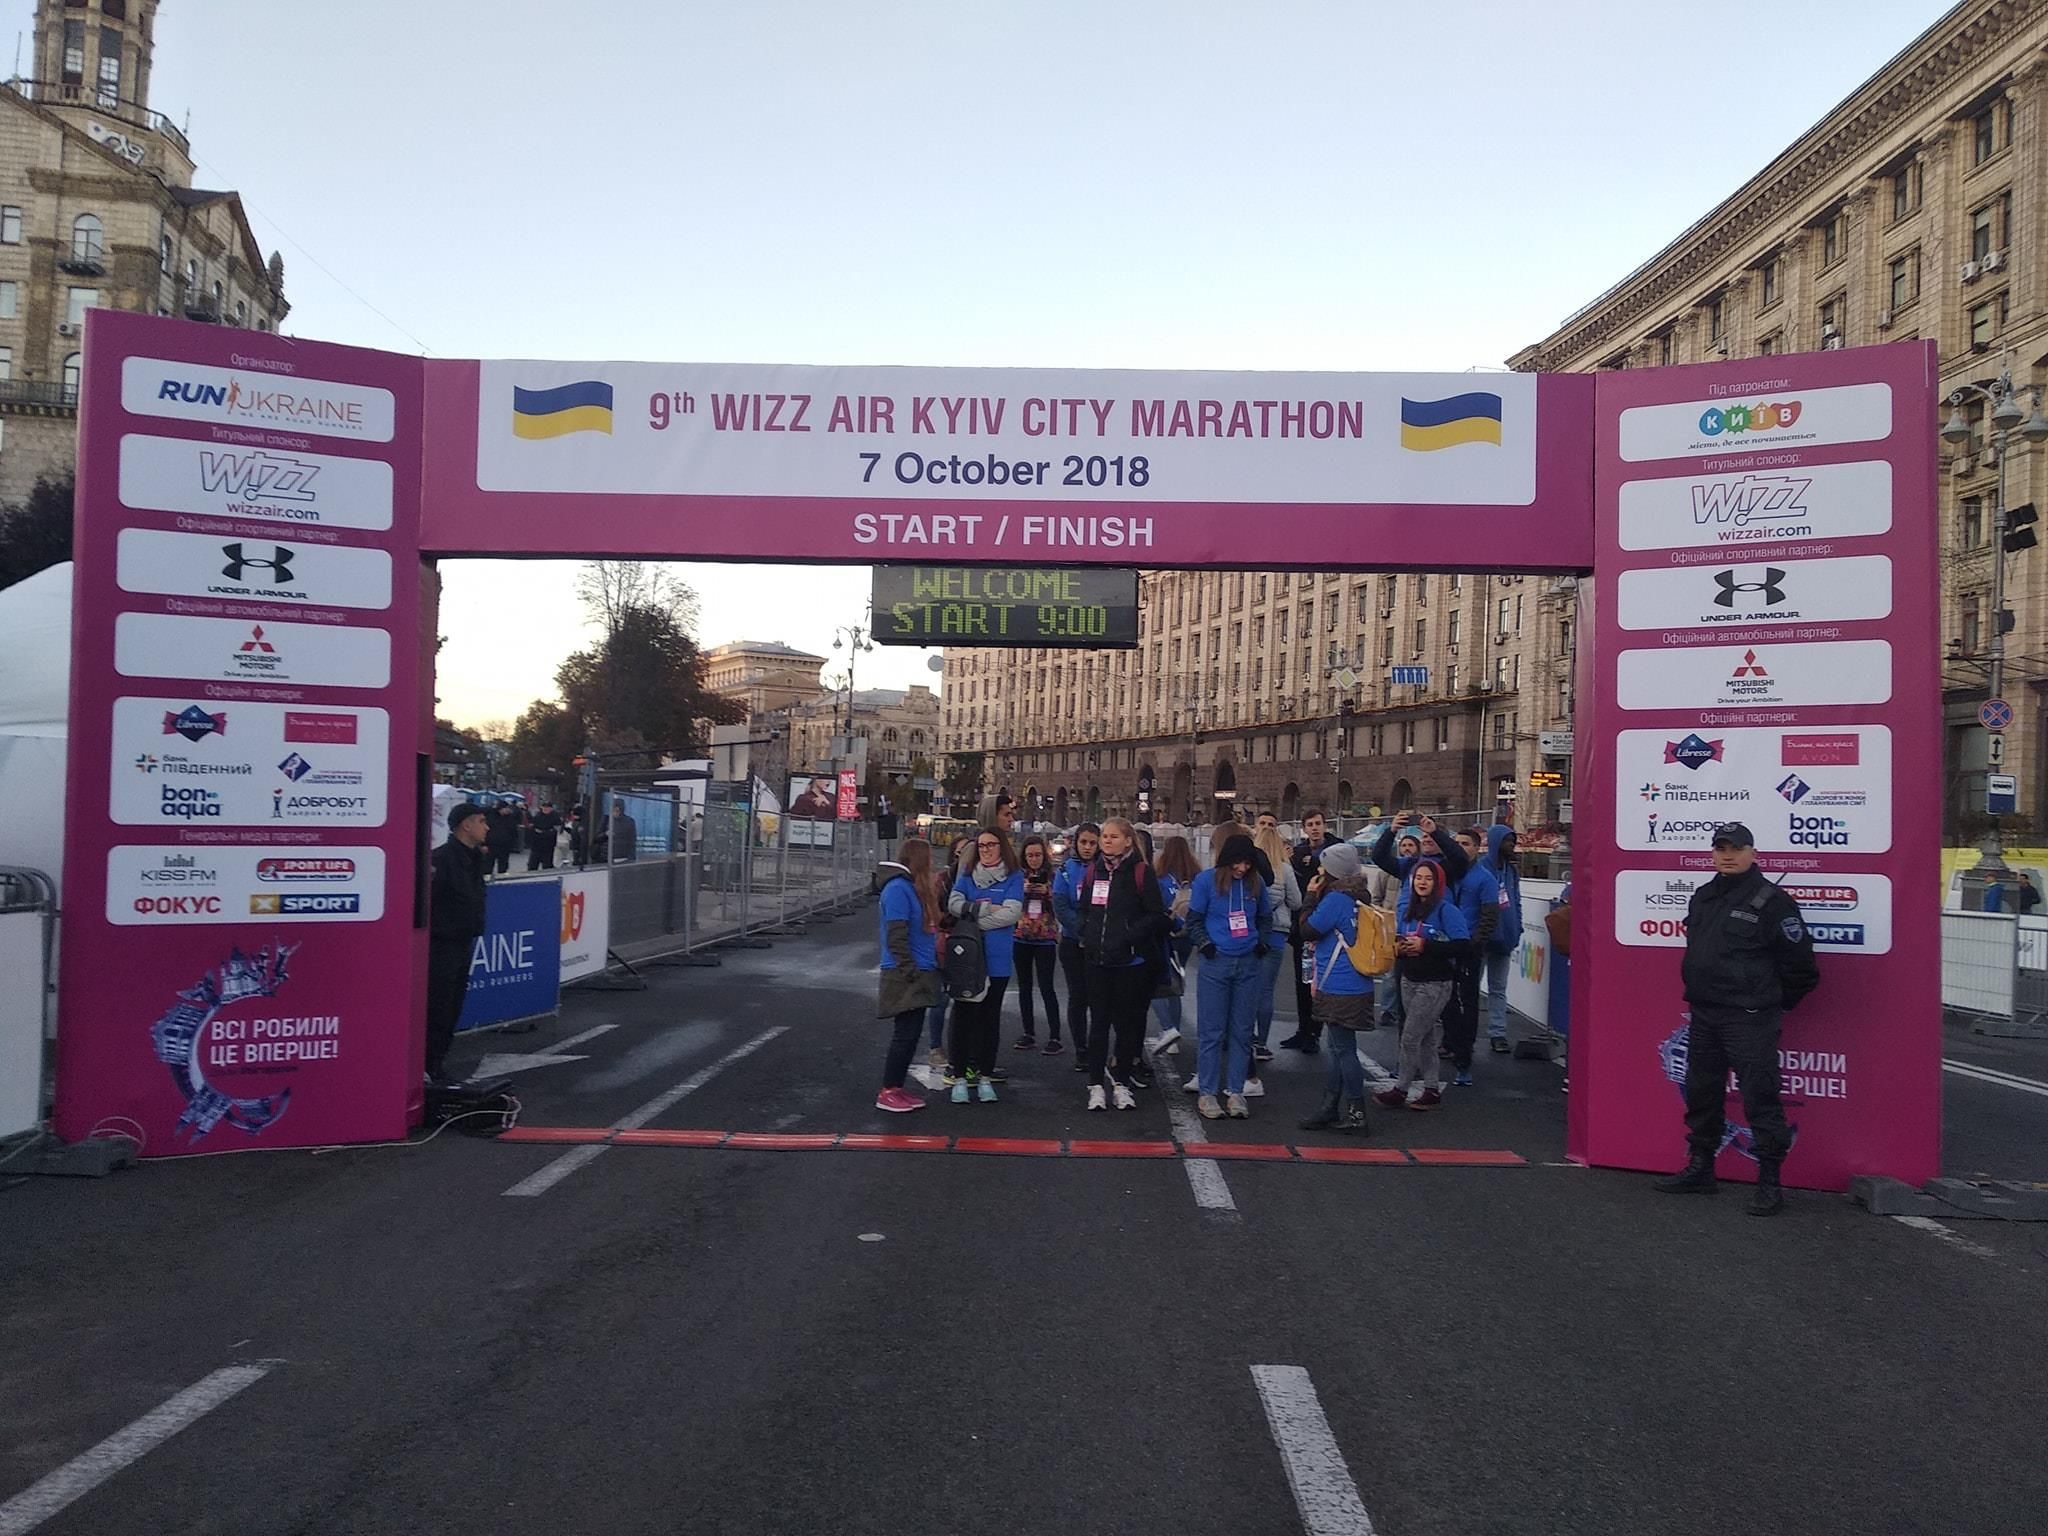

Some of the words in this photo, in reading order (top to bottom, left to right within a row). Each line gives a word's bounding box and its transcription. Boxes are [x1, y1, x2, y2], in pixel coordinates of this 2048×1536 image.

[230, 353, 295, 372] Організатор:
[1708, 383, 1727, 395] Під
[1729, 378, 1792, 395] патронатом:
[158, 380, 226, 406] RUN
[235, 390, 363, 424] UKRAINE
[649, 391, 695, 430] 9th
[711, 393, 812, 432] WIZZ
[827, 395, 895, 433] AIR
[912, 396, 1006, 435] KYIV
[1022, 397, 1116, 437] CITY
[1131, 399, 1363, 438] MARATHON
[1706, 406, 1793, 429] КИЇВ
[212, 427, 265, 444] Титульний
[267, 433, 311, 450] спонсор:
[859, 452, 881, 483] 7
[895, 451, 1050, 486] October
[1062, 455, 1150, 487] 2018
[1702, 456, 1754, 471] Титульний
[1756, 453, 1801, 467] спонсор:
[227, 502, 319, 521] wizzair.com
[176, 516, 233, 532] Офіційний
[235, 522, 295, 539] спортивний
[297, 529, 340, 543] партнер:
[853, 513, 983, 544] START
[1023, 516, 1154, 546] FINISH
[1717, 523, 1812, 541] wizzair.com
[1671, 549, 1724, 564] Офіційний
[1726, 545, 1786, 561] спортивний
[1788, 543, 1834, 557] партнер:
[208, 586, 250, 595] UNDER
[254, 589, 307, 599] ARMOUR
[912, 568, 1081, 600] WELCOME
[892, 602, 1016, 634] START
[1037, 604, 1107, 636] 9:00
[1701, 614, 1742, 622] UNDER
[1745, 611, 1800, 620] ARMOUR
[1662, 631, 1716, 645] Офіційний
[1717, 628, 1794, 642] автомобільний
[1796, 626, 1842, 640] партнер:
[233, 654, 282, 663] MITSUBISHI
[239, 662, 275, 670] MOTORS
[1726, 680, 1775, 688] MITSUBISHI
[1732, 687, 1769, 695] MOTORS
[1700, 711, 1745, 725] Офіційні
[1746, 711, 1798, 724] партнери:
[163, 754, 187, 762] банк
[1676, 747, 1712, 758] Libresse
[162, 763, 252, 776] ПІВДЕННИЙ
[162, 784, 206, 801] bon
[1665, 783, 1688, 791] банк
[1665, 789, 1750, 801] ПІВДЕННИЙ
[161, 802, 220, 819] aqua
[287, 797, 368, 809] ДОБРОБУТ
[1662, 821, 1742, 832] ДОБРОБ
[1790, 813, 1832, 830] bon
[179, 830, 238, 843] Генеральні
[1789, 831, 1849, 848] aqua
[283, 861, 320, 870] SPORT
[325, 861, 349, 871] LIFE
[1680, 854, 1714, 868] Генера
[1769, 856, 1821, 870] партнери:
[141, 870, 187, 881] KISS
[190, 870, 216, 880] FM
[1645, 893, 1687, 905] KISS
[1825, 889, 1851, 899] LIFE
[134, 896, 221, 914] ФОКУС
[283, 897, 355, 911] SPORT
[1640, 920, 1687, 937] ФОК
[1807, 926, 1859, 941] ORT
[468, 930, 534, 976] AINE
[489, 972, 534, 986] RUNNERS
[211, 1020, 245, 1040] ВСІ
[253, 1016, 339, 1038] РОБИЛИ
[210, 1045, 238, 1066] ЦЕ
[244, 1040, 339, 1063] ВПЕРШЕ!
[1777, 1050, 1847, 1074] БИЛИ
[1779, 1075, 1847, 1098] ЕРШЕ!
